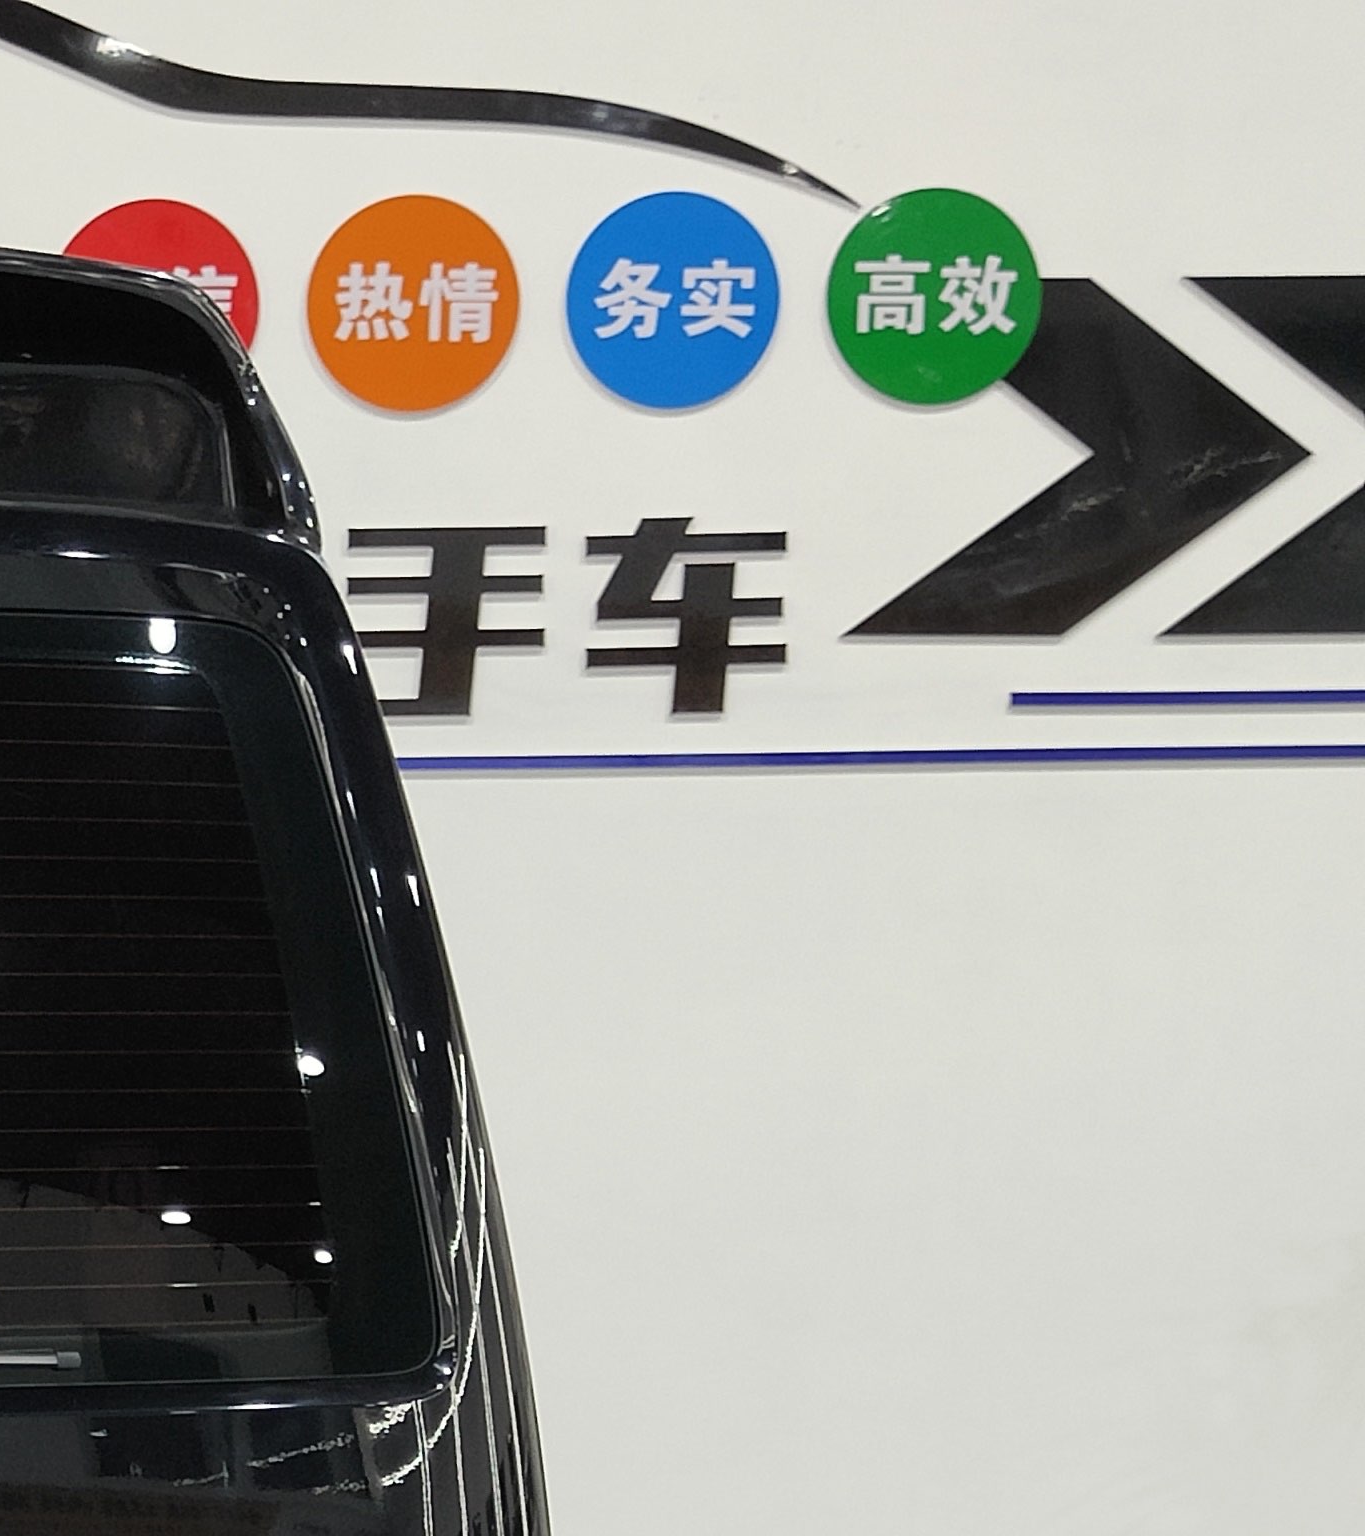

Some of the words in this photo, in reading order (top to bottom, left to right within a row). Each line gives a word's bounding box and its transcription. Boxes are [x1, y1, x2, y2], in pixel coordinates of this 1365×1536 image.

[334, 261, 499, 343] 热情
[594, 258, 756, 339] 务实
[854, 255, 1018, 336] 高效
